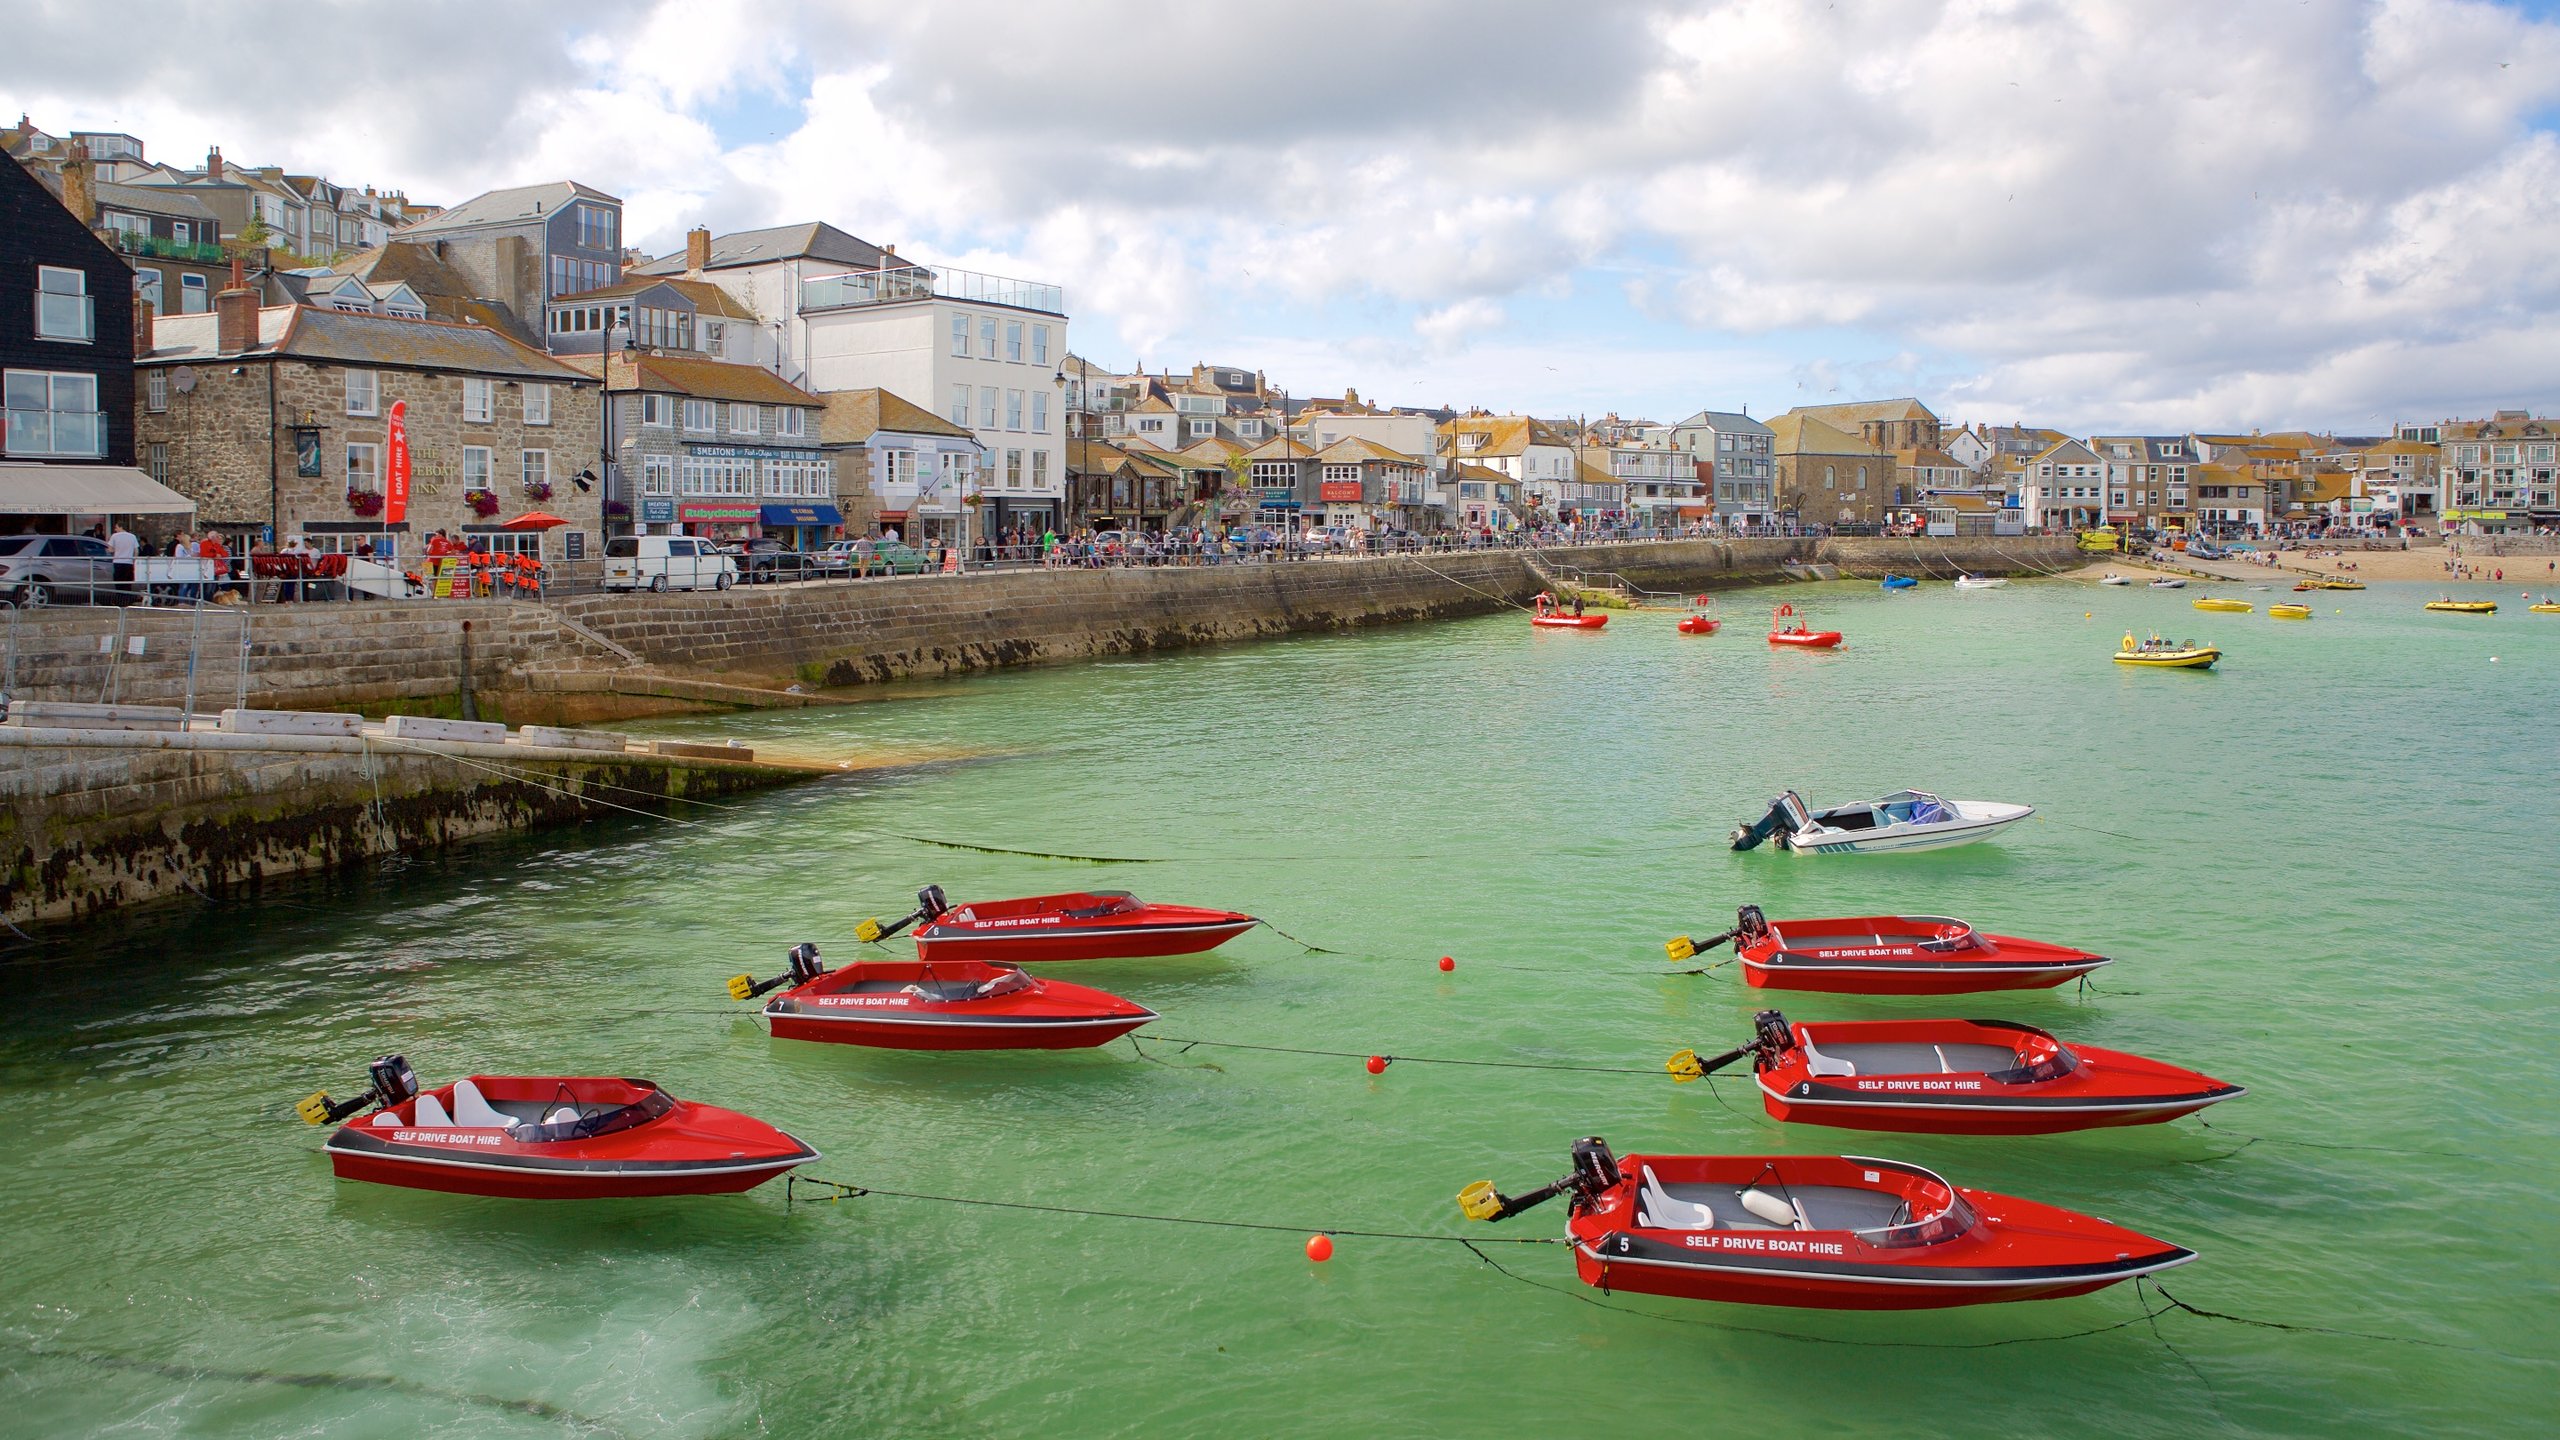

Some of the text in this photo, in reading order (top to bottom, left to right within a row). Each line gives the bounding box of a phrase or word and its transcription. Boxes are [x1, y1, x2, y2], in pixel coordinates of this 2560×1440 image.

[416, 448, 440, 458] THE
[697, 447, 736, 456] SMEATONS
[395, 446, 403, 468] HIRE
[411, 466, 456, 476] FEBOAT
[395, 471, 403, 495] BOAT
[416, 484, 440, 494] INN
[995, 919, 1018, 927] DRIVE
[933, 927, 939, 936] 6
[1776, 953, 1783, 963] 8
[778, 1001, 784, 1011] 7
[818, 998, 909, 1006] SELF DRIVE BOAT HIRE
[1802, 1083, 1810, 1095] 9
[1858, 1080, 1981, 1090] SELF DRIVE BOAT HIRE
[392, 1131, 502, 1145] SELF DRIVE BOAT HIRE
[1590, 1151, 1610, 1186] MERCURY
[1620, 1237, 1630, 1252] 5
[1685, 1235, 1843, 1255] SELF DRIVE BOAT HIRE
